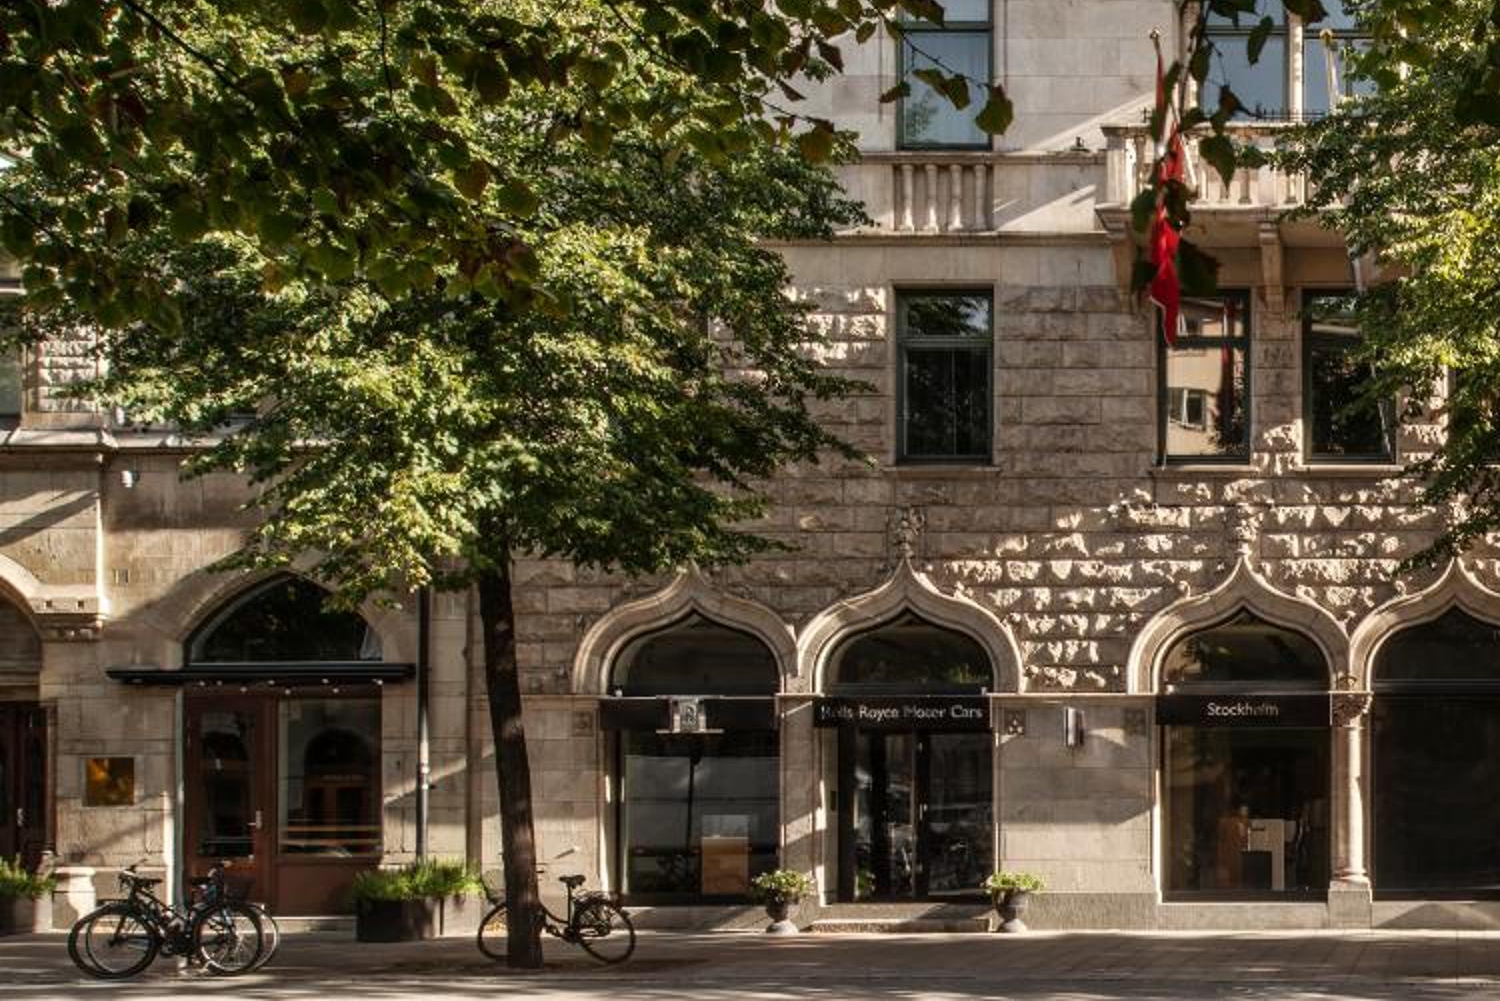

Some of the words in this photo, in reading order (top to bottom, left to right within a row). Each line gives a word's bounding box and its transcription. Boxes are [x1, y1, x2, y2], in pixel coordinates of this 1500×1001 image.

[859, 705, 898, 721] Royce
[951, 705, 983, 718] Cars
[1207, 702, 1279, 716] Stockholm
